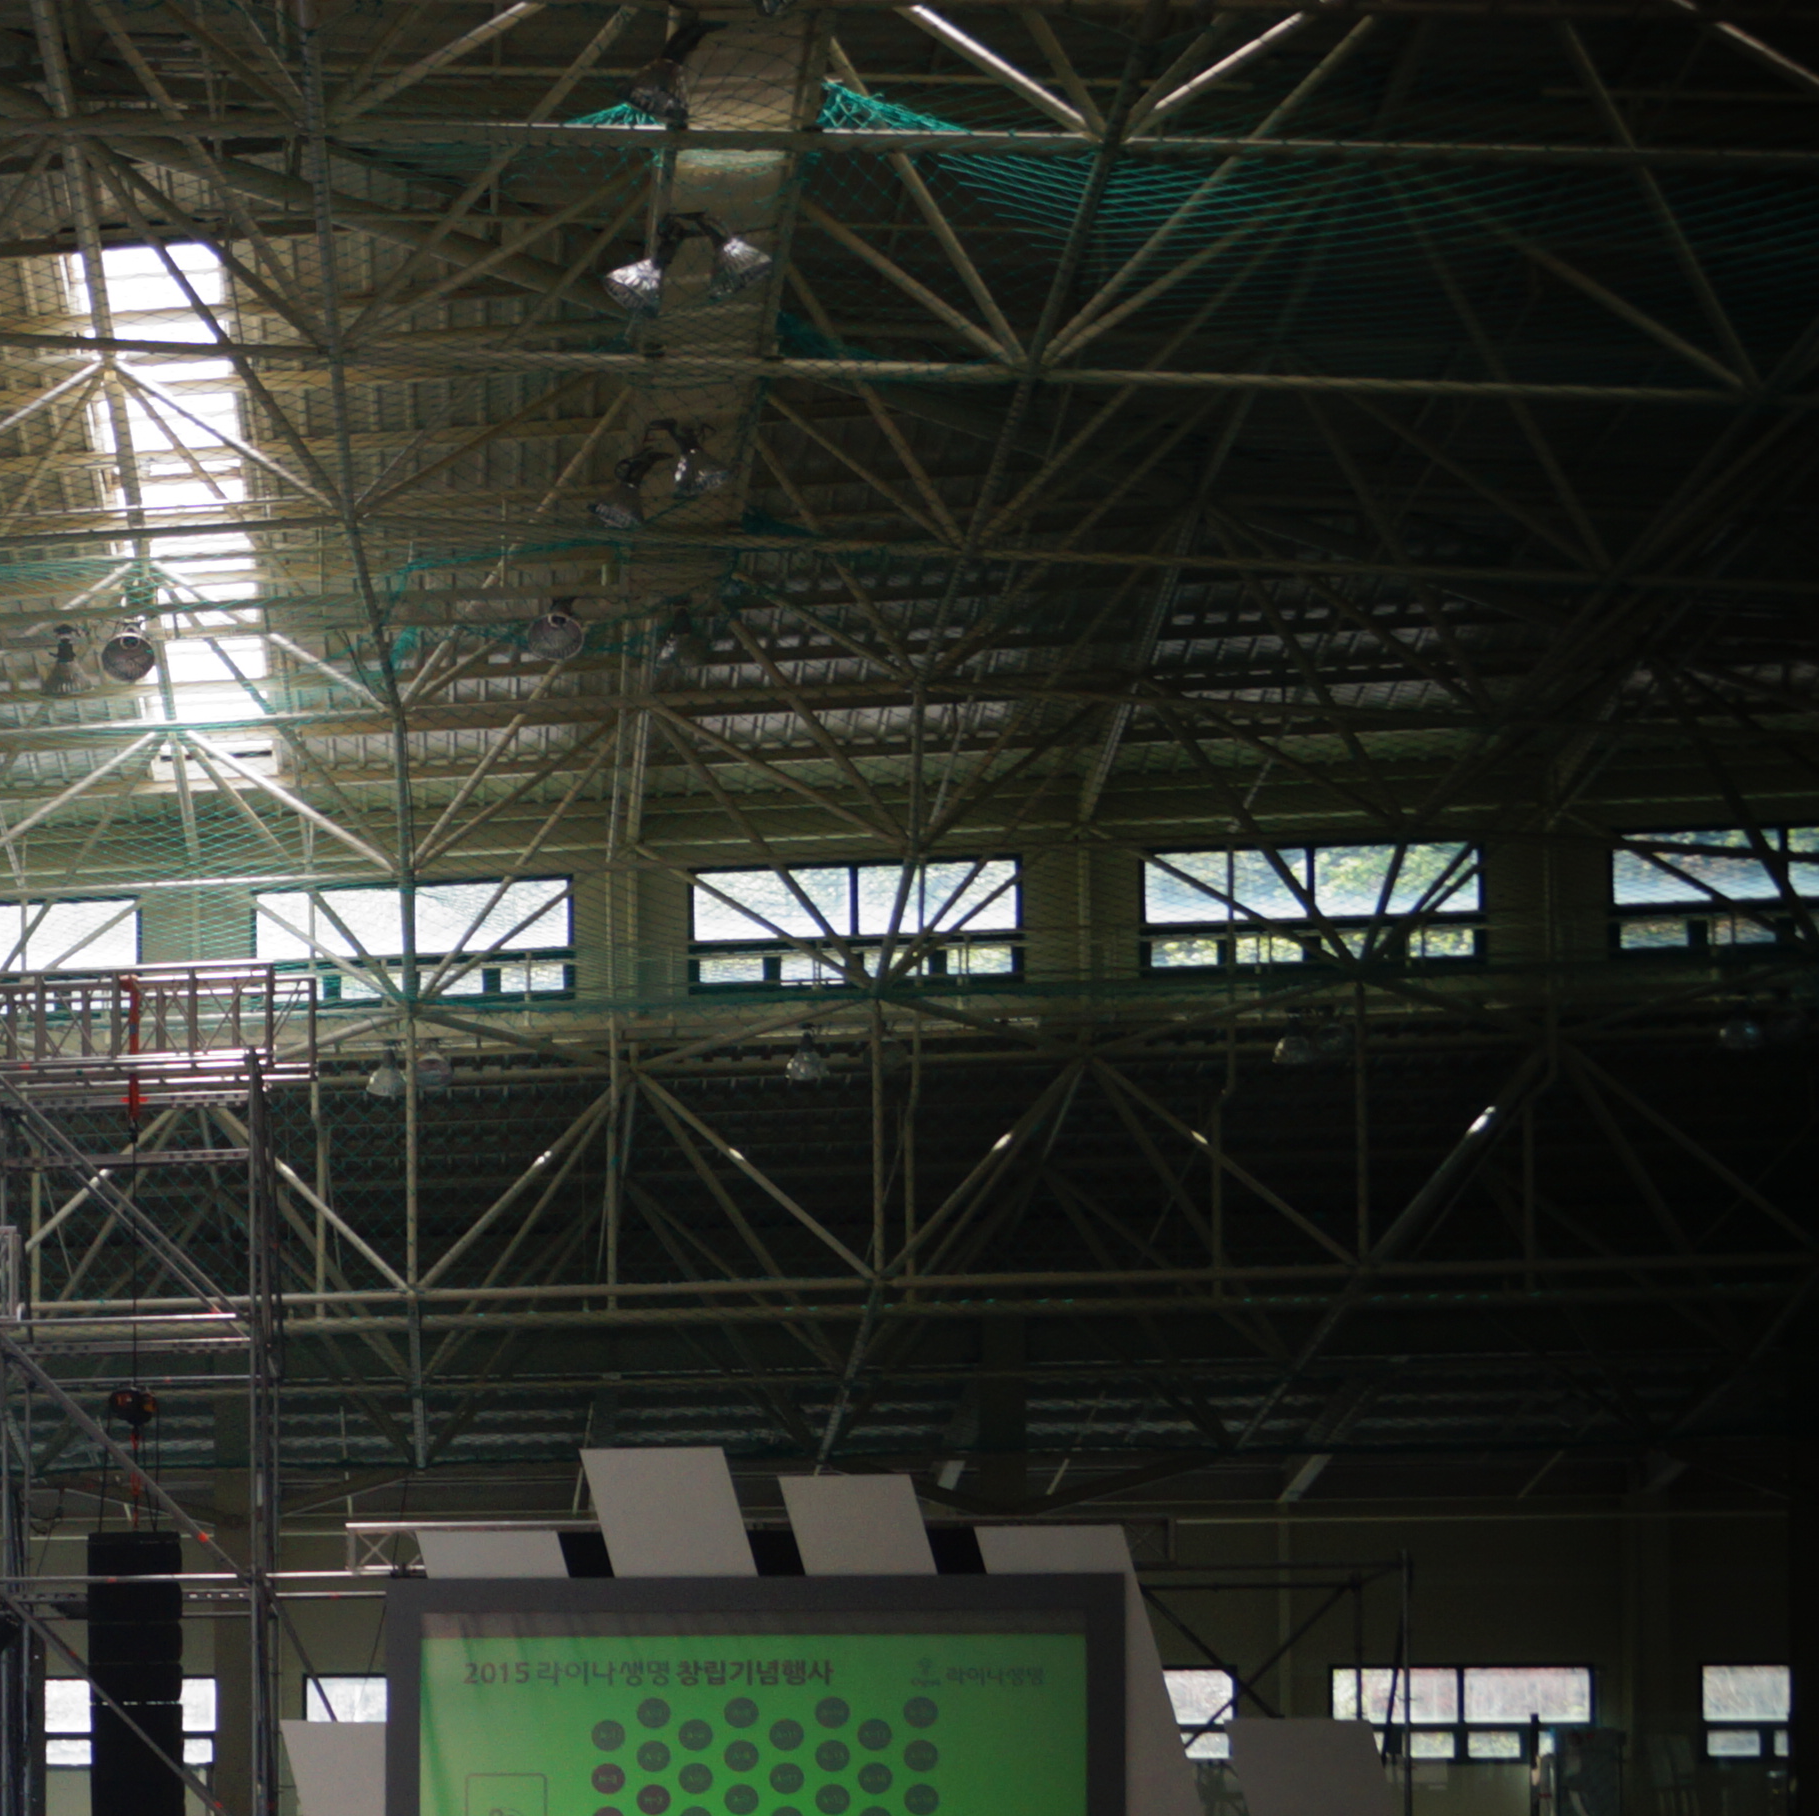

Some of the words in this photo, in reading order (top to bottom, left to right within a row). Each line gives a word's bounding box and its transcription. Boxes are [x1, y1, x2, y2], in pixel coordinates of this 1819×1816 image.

[463, 1661, 531, 1685] 2015
[537, 1659, 671, 1687] 라이나생명
[676, 1658, 835, 1687] 창립기념행사
